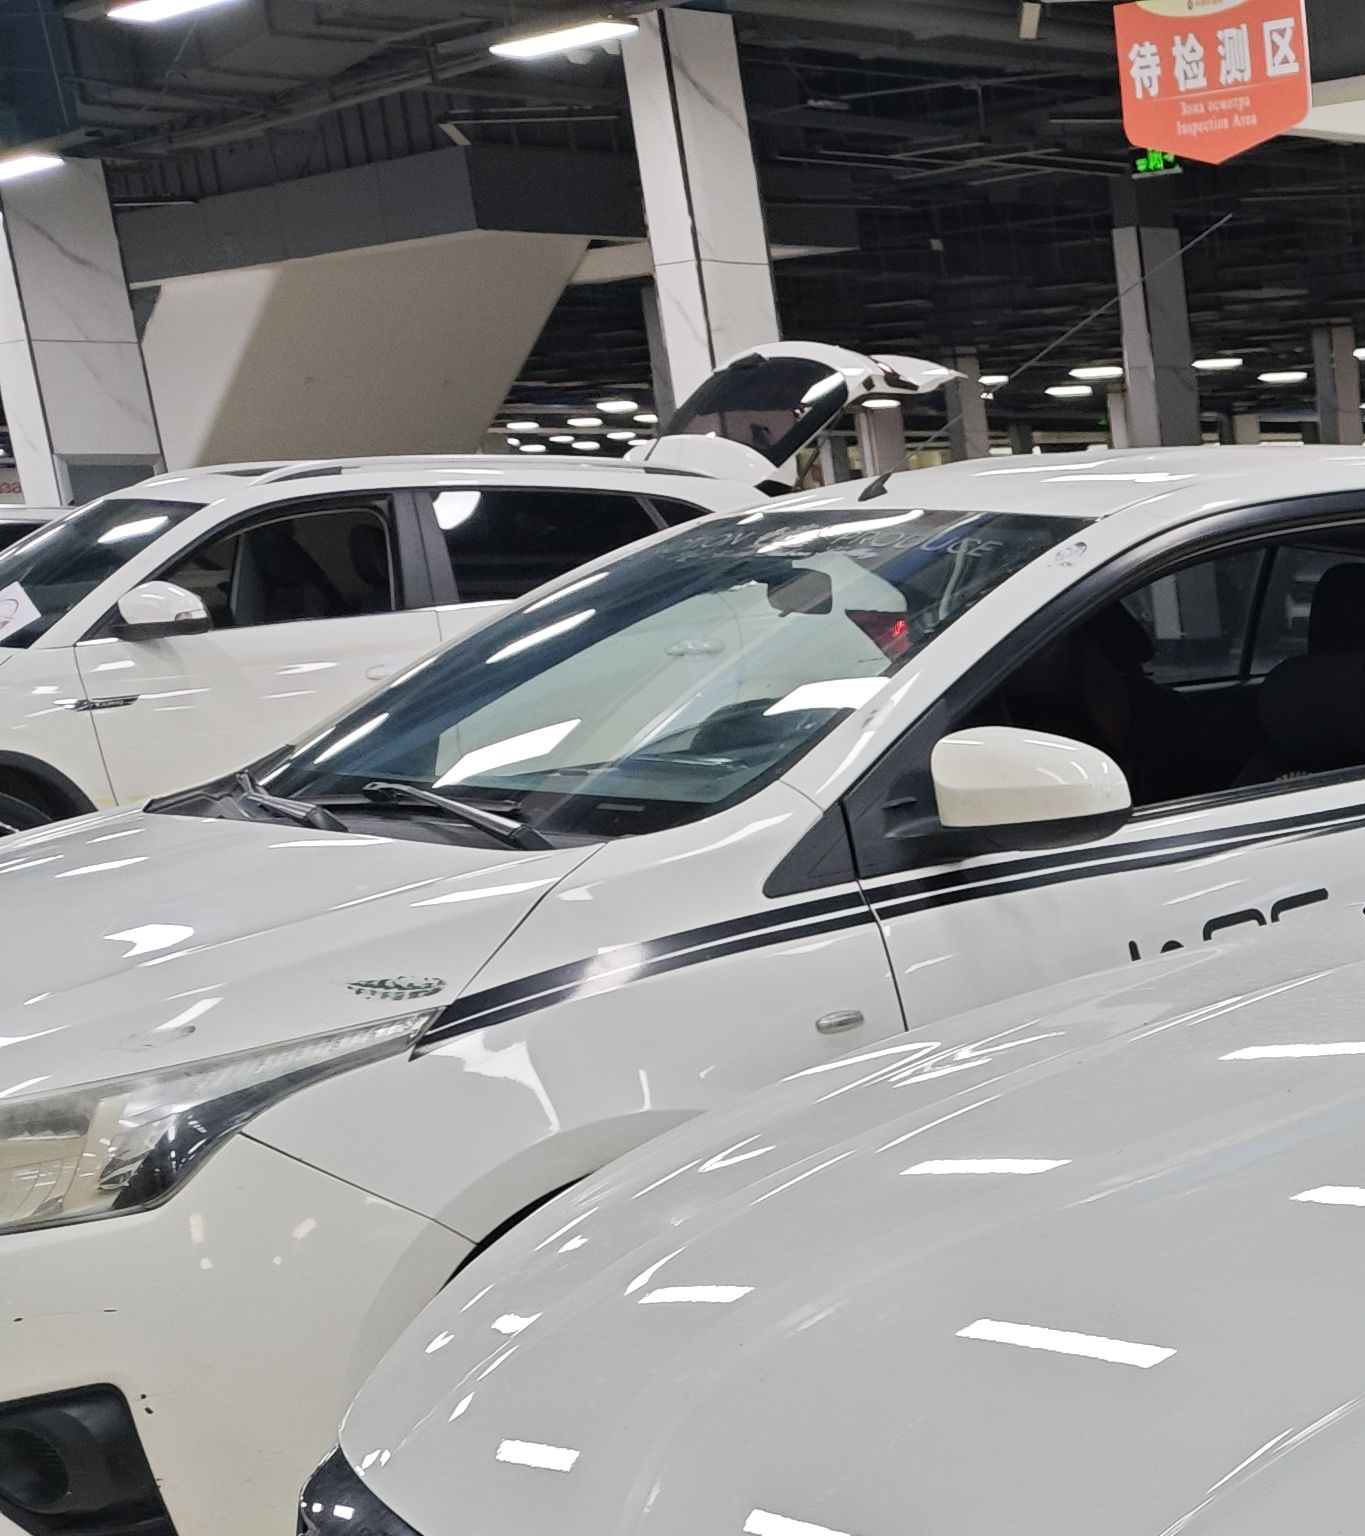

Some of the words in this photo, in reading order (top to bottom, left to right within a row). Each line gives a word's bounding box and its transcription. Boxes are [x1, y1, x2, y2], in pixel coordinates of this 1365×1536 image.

[1128, 17, 1300, 99] 待检测区
[1176, 115, 1229, 136] Inspection
[1232, 113, 1257, 128] Area
